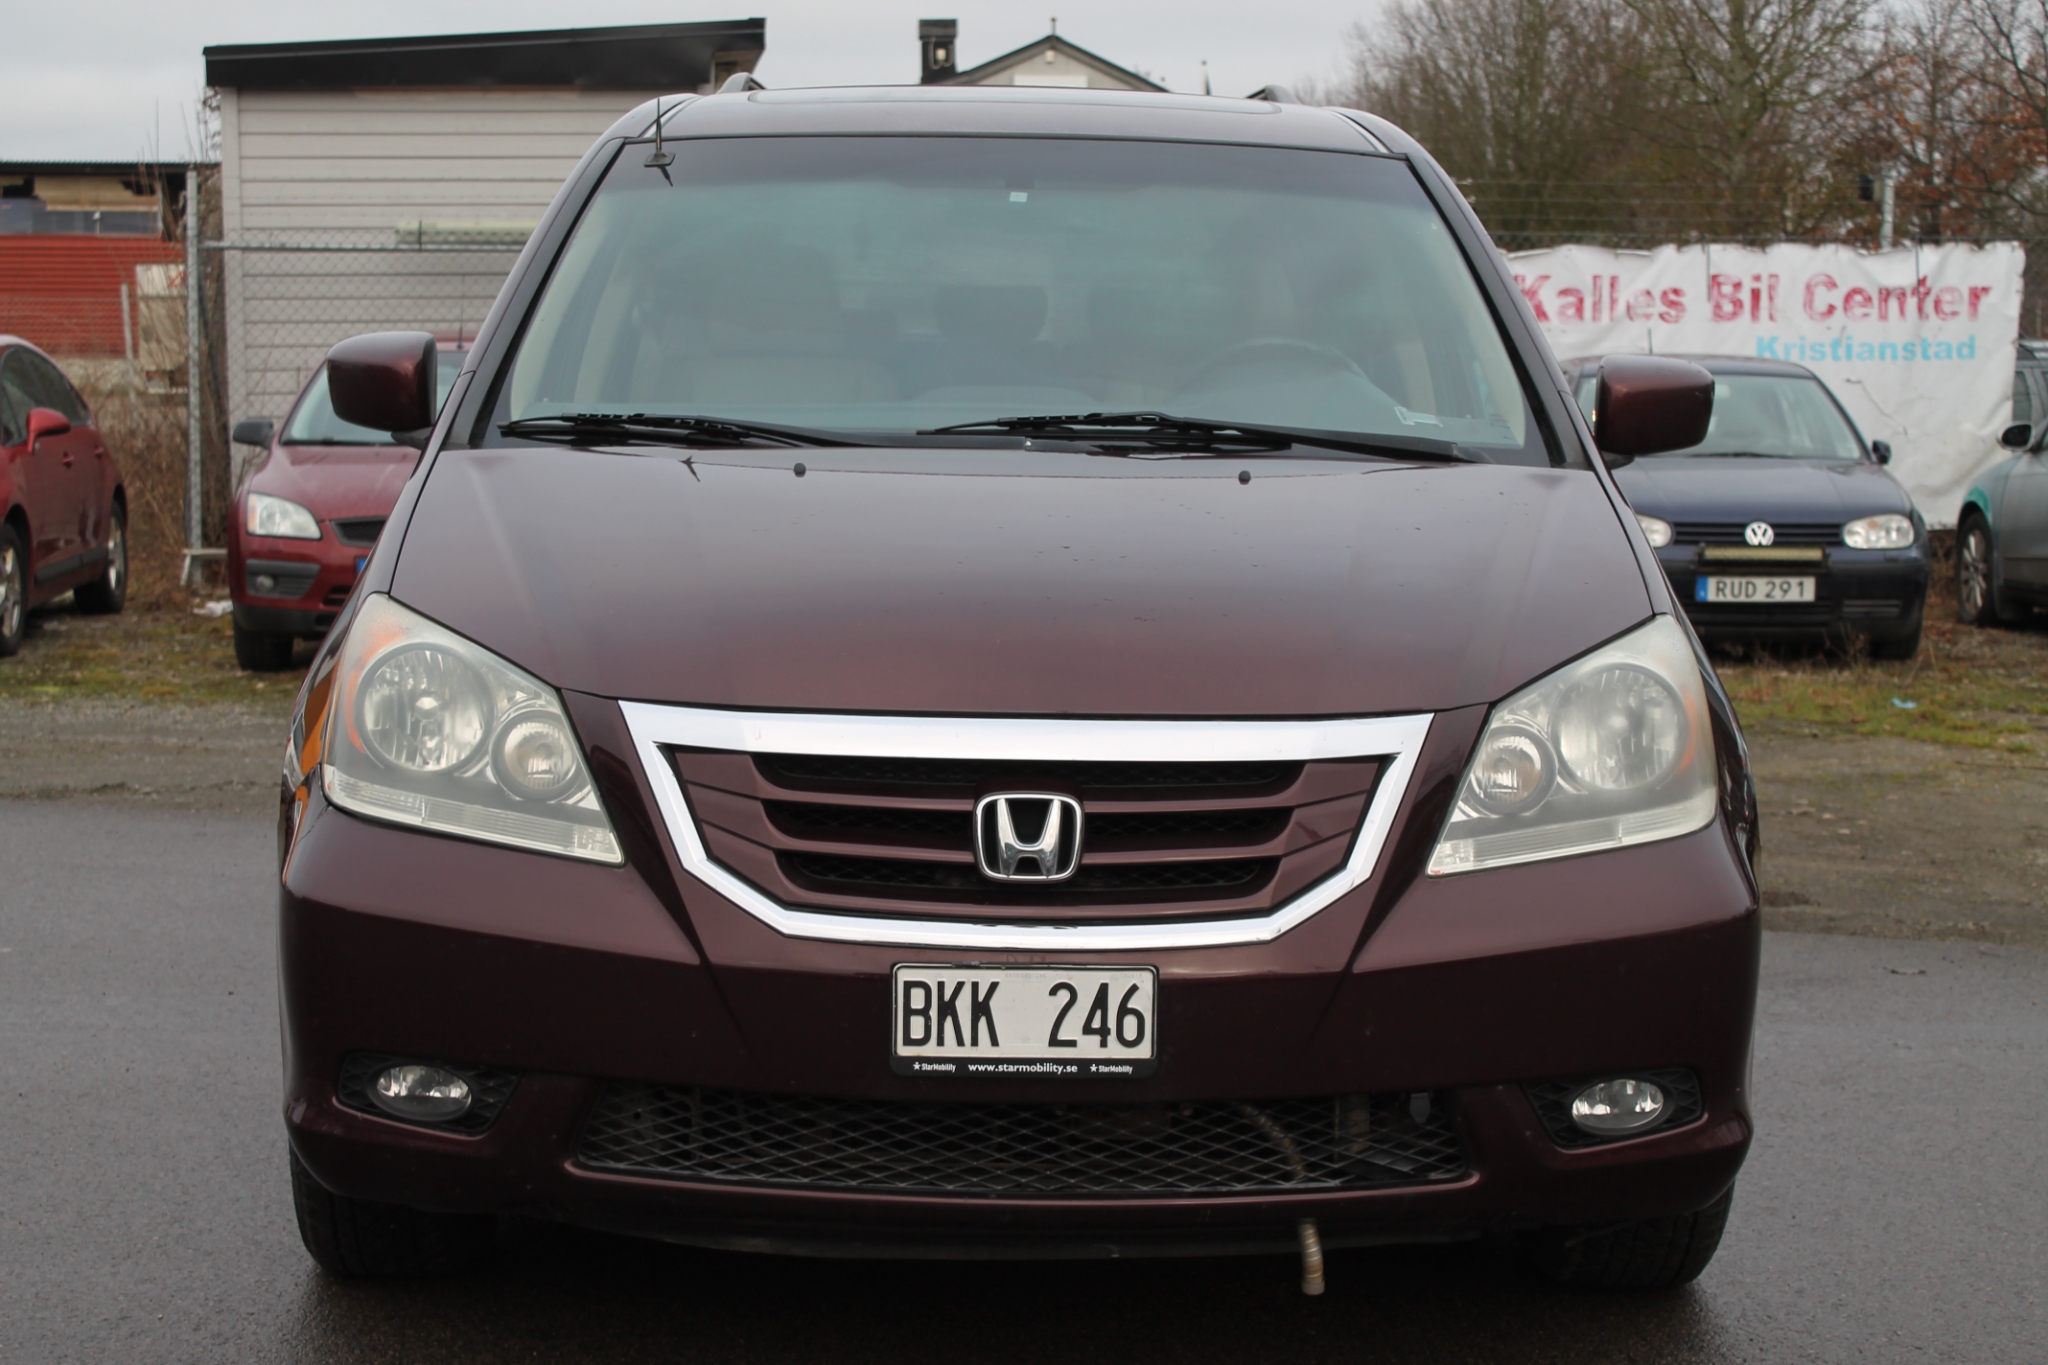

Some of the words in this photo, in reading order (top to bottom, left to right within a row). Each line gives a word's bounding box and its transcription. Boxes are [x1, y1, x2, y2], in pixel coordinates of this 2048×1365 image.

[1514, 274, 1687, 324] Kalles
[1710, 273, 1780, 323] Bil
[1803, 273, 1992, 322] Center
[1756, 334, 1976, 362] Kristianstad
[1716, 580, 1757, 599] RUD
[1765, 580, 1805, 599] 291
[903, 980, 1000, 1047] BKK
[1048, 981, 1146, 1048] 246
[968, 1063, 1078, 1075] www.starmobility.se
